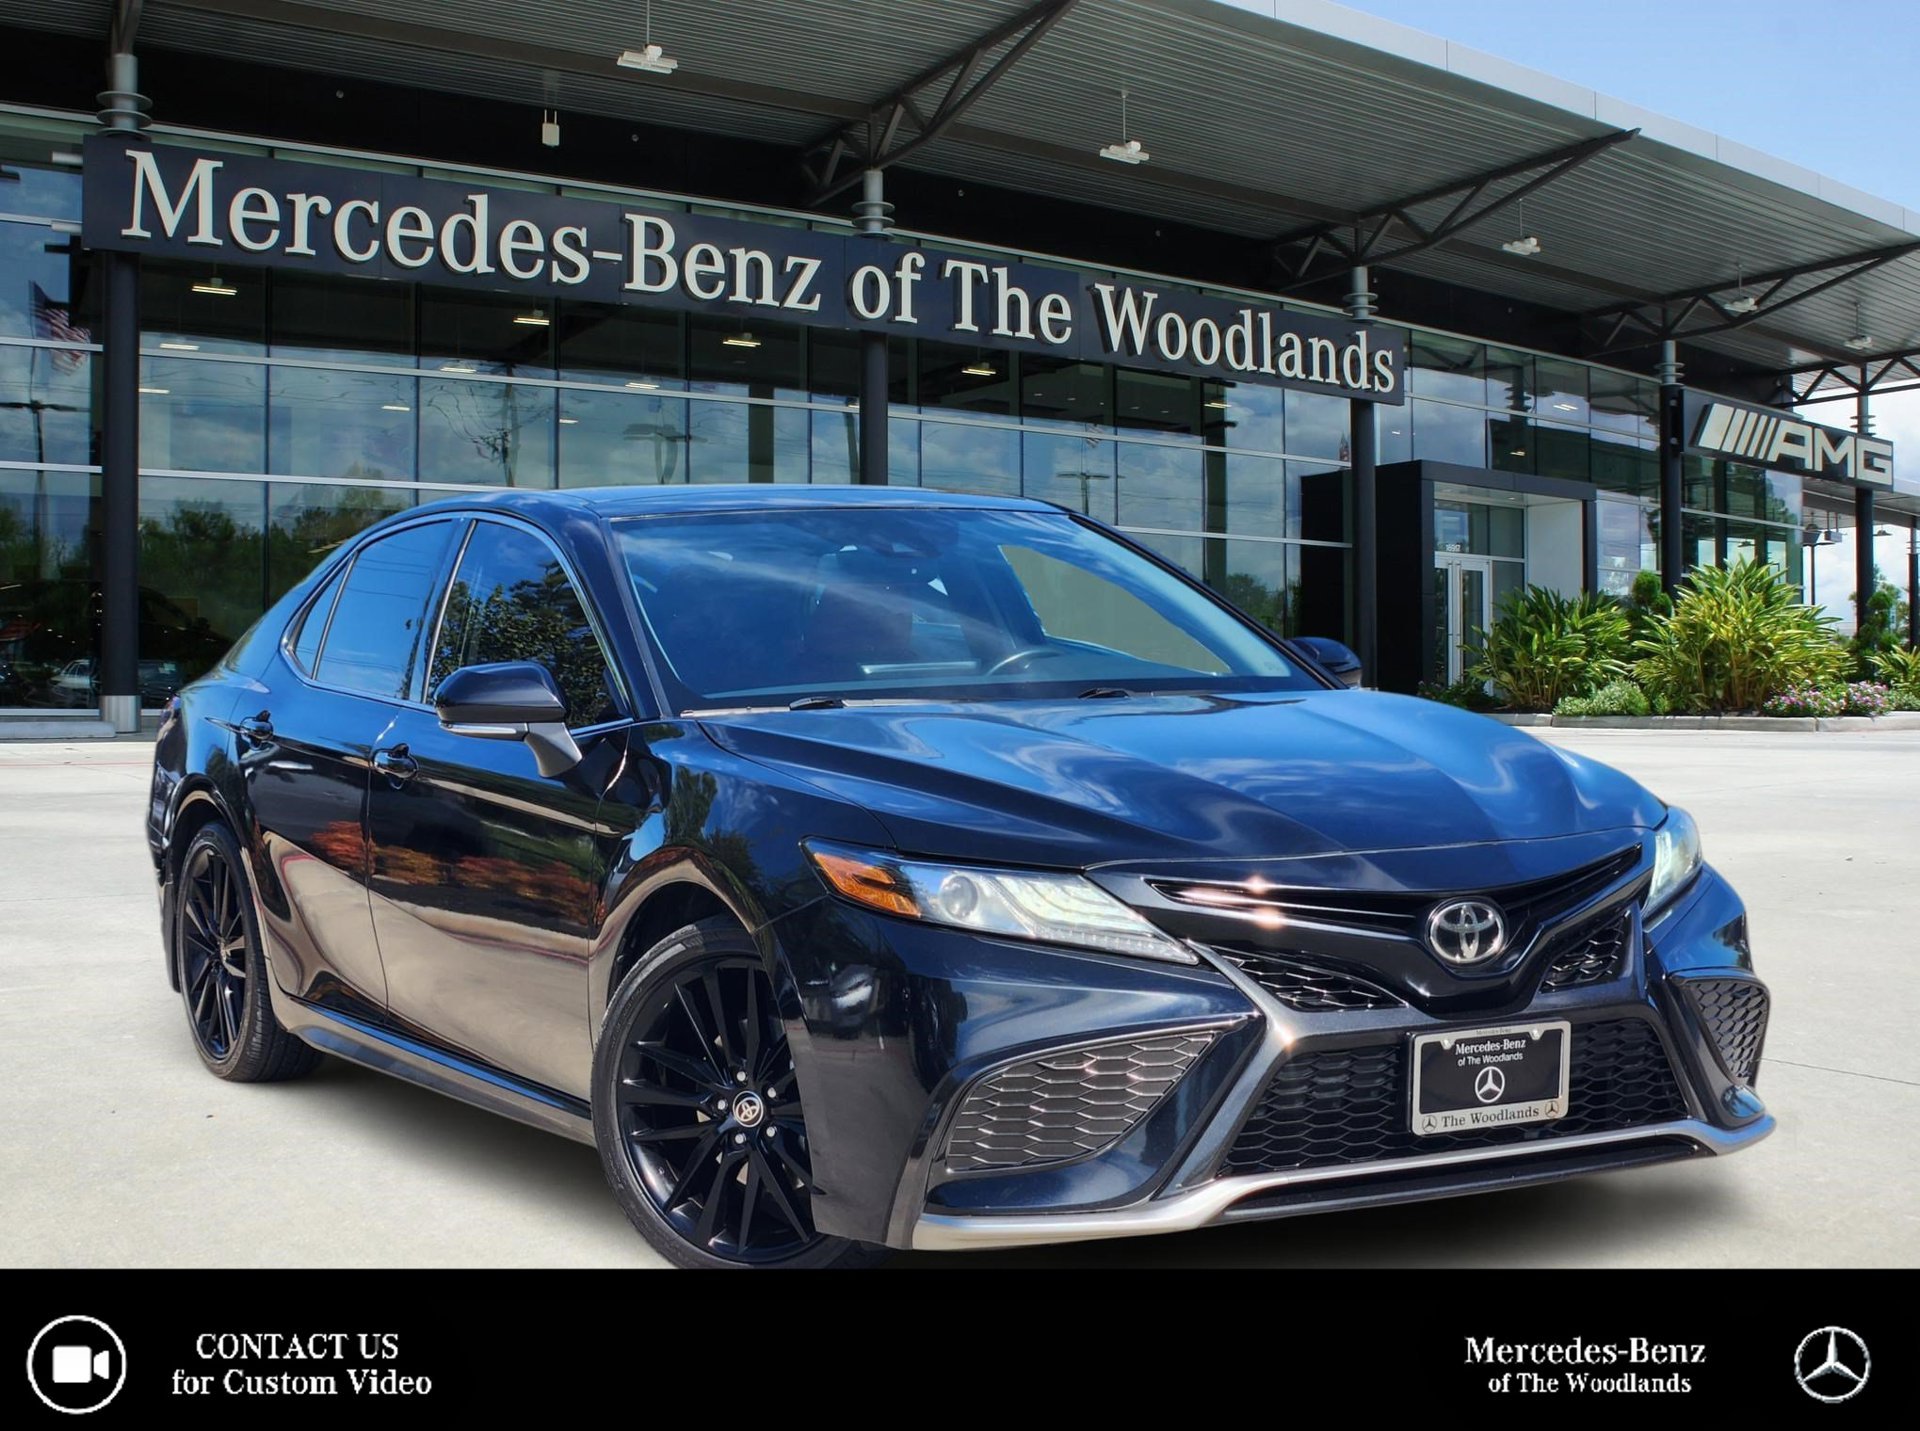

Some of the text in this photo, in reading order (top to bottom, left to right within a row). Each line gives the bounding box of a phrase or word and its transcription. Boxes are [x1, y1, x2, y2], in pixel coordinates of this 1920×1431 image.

[121, 149, 1395, 393] Mercedes-Benz of The Woodlands
[1767, 419, 1893, 486] AMG
[1456, 1039, 1526, 1055] Mercedes-Benz
[1457, 1052, 1523, 1067] of The Woodlands
[1441, 1106, 1540, 1128] The Woodlands
